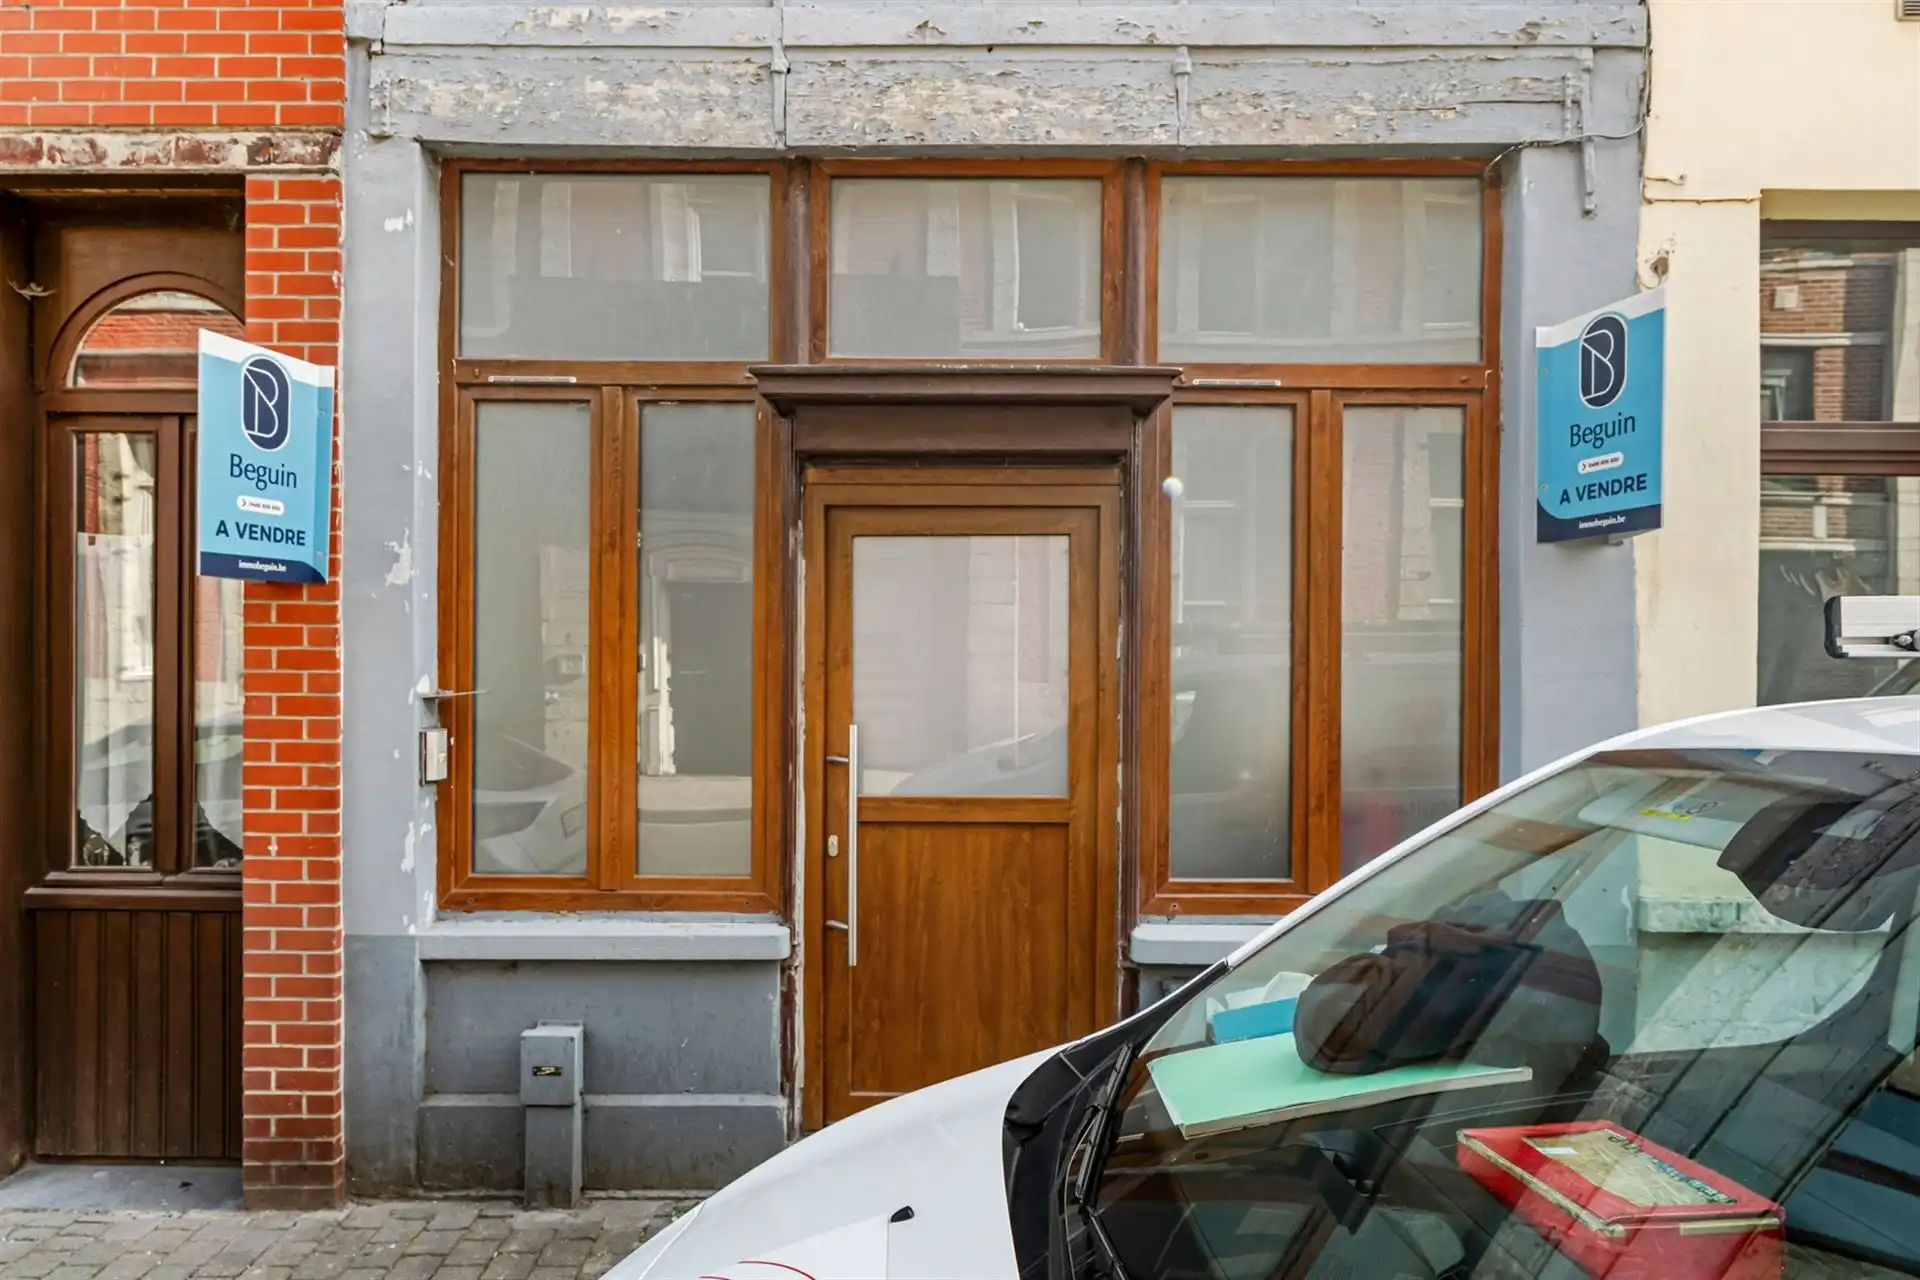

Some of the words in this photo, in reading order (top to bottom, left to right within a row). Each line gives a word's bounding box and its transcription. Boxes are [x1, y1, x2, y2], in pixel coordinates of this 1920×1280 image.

[1570, 412, 1635, 449] Beguin
[230, 453, 297, 491] Beguin
[1560, 489, 1571, 505] A
[1576, 474, 1647, 500] VENDRE
[216, 520, 229, 537] A
[235, 522, 305, 546] VENDRE
